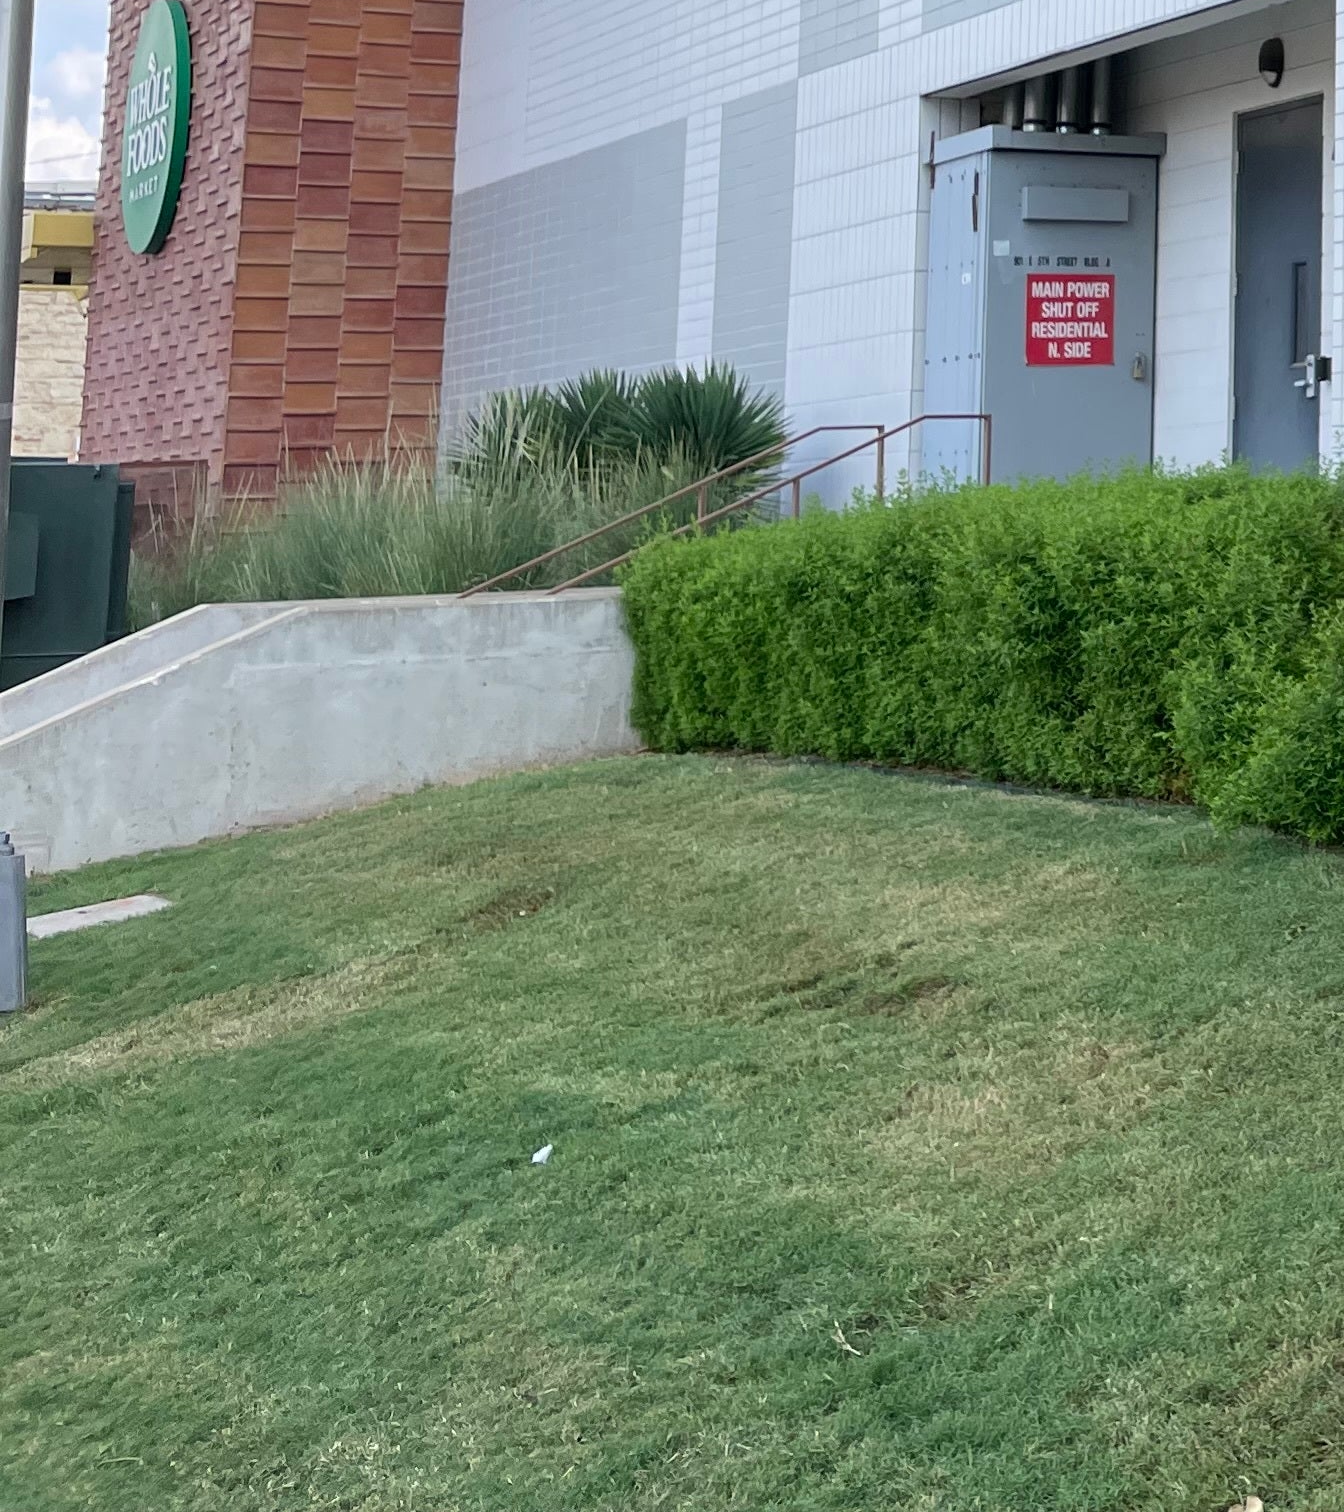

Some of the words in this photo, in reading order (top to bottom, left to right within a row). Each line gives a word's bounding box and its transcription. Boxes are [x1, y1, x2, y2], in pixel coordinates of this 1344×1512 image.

[130, 51, 172, 129] WHOLE
[126, 115, 168, 177] FOODS
[129, 175, 159, 203] MARKET
[1031, 281, 1064, 298] MAIN
[1067, 282, 1110, 298] POWER
[1041, 301, 1074, 318] SHUT
[1076, 302, 1100, 318] OFF
[1031, 321, 1109, 339] RESIDENTIAL
[1048, 341, 1061, 358] N.
[1063, 342, 1092, 358] SIDE
